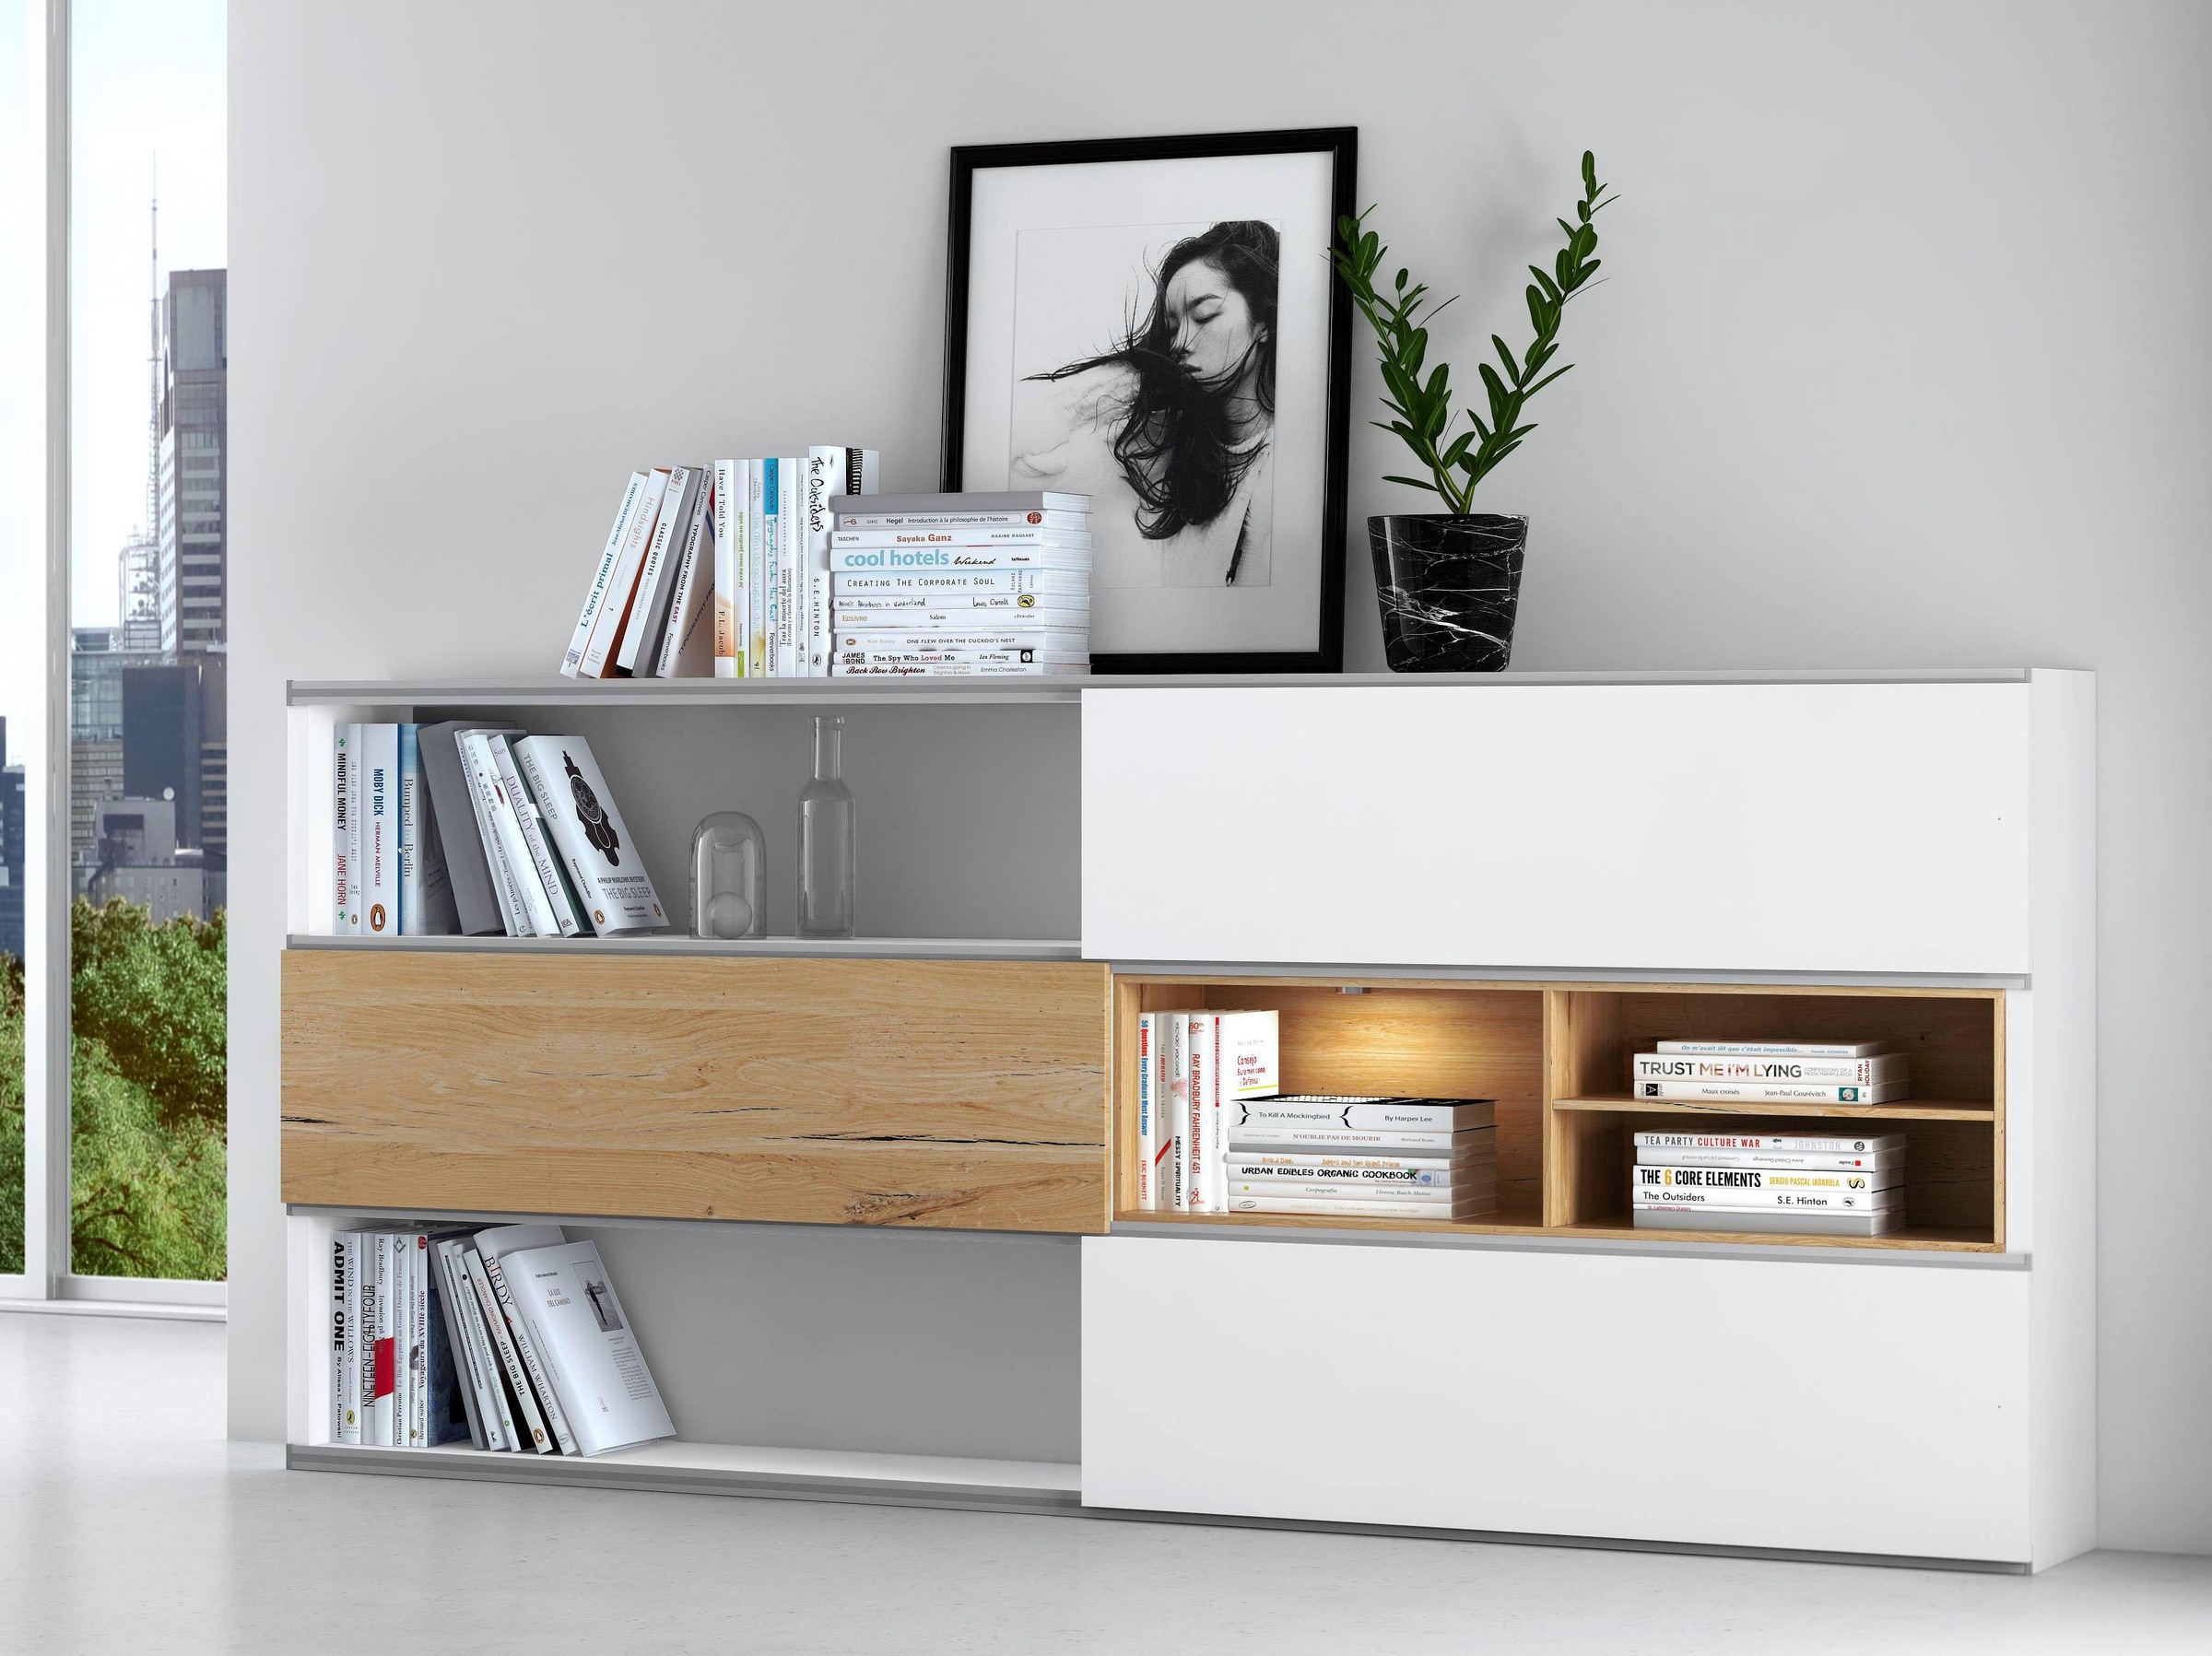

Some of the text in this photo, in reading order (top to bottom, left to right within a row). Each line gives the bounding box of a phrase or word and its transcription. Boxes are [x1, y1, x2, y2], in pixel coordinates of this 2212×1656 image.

[809, 457, 825, 532] The Outsiders
[629, 497, 655, 549] Hindsights
[927, 534, 952, 542] Ganz
[647, 523, 667, 577] CLASSIC QUOTES
[684, 523, 699, 570] TYPOGRAPHY
[844, 549, 996, 567] cool hotels Weekend
[581, 591, 600, 628] L'écrit
[596, 552, 614, 590] primal
[679, 570, 688, 591] FROM
[672, 606, 680, 624] EAST
[660, 632, 674, 671] Foreverbooks
[493, 747, 506, 756] Sun
[373, 769, 384, 816] MOBY DICK
[402, 779, 413, 827] Bumped
[524, 753, 558, 820] THE BIG SLEEP
[337, 753, 347, 905] MINDFUL MONEY JANE HORN
[404, 829, 411, 840] to
[506, 776, 535, 831] DUALITY
[528, 834, 536, 845] of
[538, 858, 559, 895] MIND
[404, 843, 413, 877] Berlin
[602, 887, 651, 899] THE BIG SLEEP
[1640, 1062, 1696, 1075] TRUST
[1699, 1063, 1724, 1076] ME
[1754, 1063, 1802, 1078] LYING
[1192, 1053, 1200, 1174] RAY BRADBURY FAHRENHEIT 451
[1287, 1112, 1331, 1121] Mockingbird
[1644, 1135, 1841, 1150] TEA PARTY CULTURE WAR JOHNSTON
[1241, 1167, 1274, 1175] URBAN
[1362, 1170, 1418, 1180] COOKBOOK
[1640, 1169, 1761, 1188] THE 6 CORE ELEMENTS
[1643, 1191, 1828, 1205] The Outsiders S.E. Hinton
[335, 1240, 345, 1304] ADMIT
[347, 1288, 352, 1297] IN
[335, 1311, 345, 1351] ONE
[362, 1285, 375, 1407] NINETEEN-EIGHTYFOUR
[477, 1277, 525, 1396] THE BIG SLEEP RAYMOND CHANDLER
[484, 1255, 512, 1306] BIRDY
[518, 1333, 537, 1372] WILLIAM
[535, 1373, 558, 1420] WHARTON
[336, 1357, 342, 1367] By
